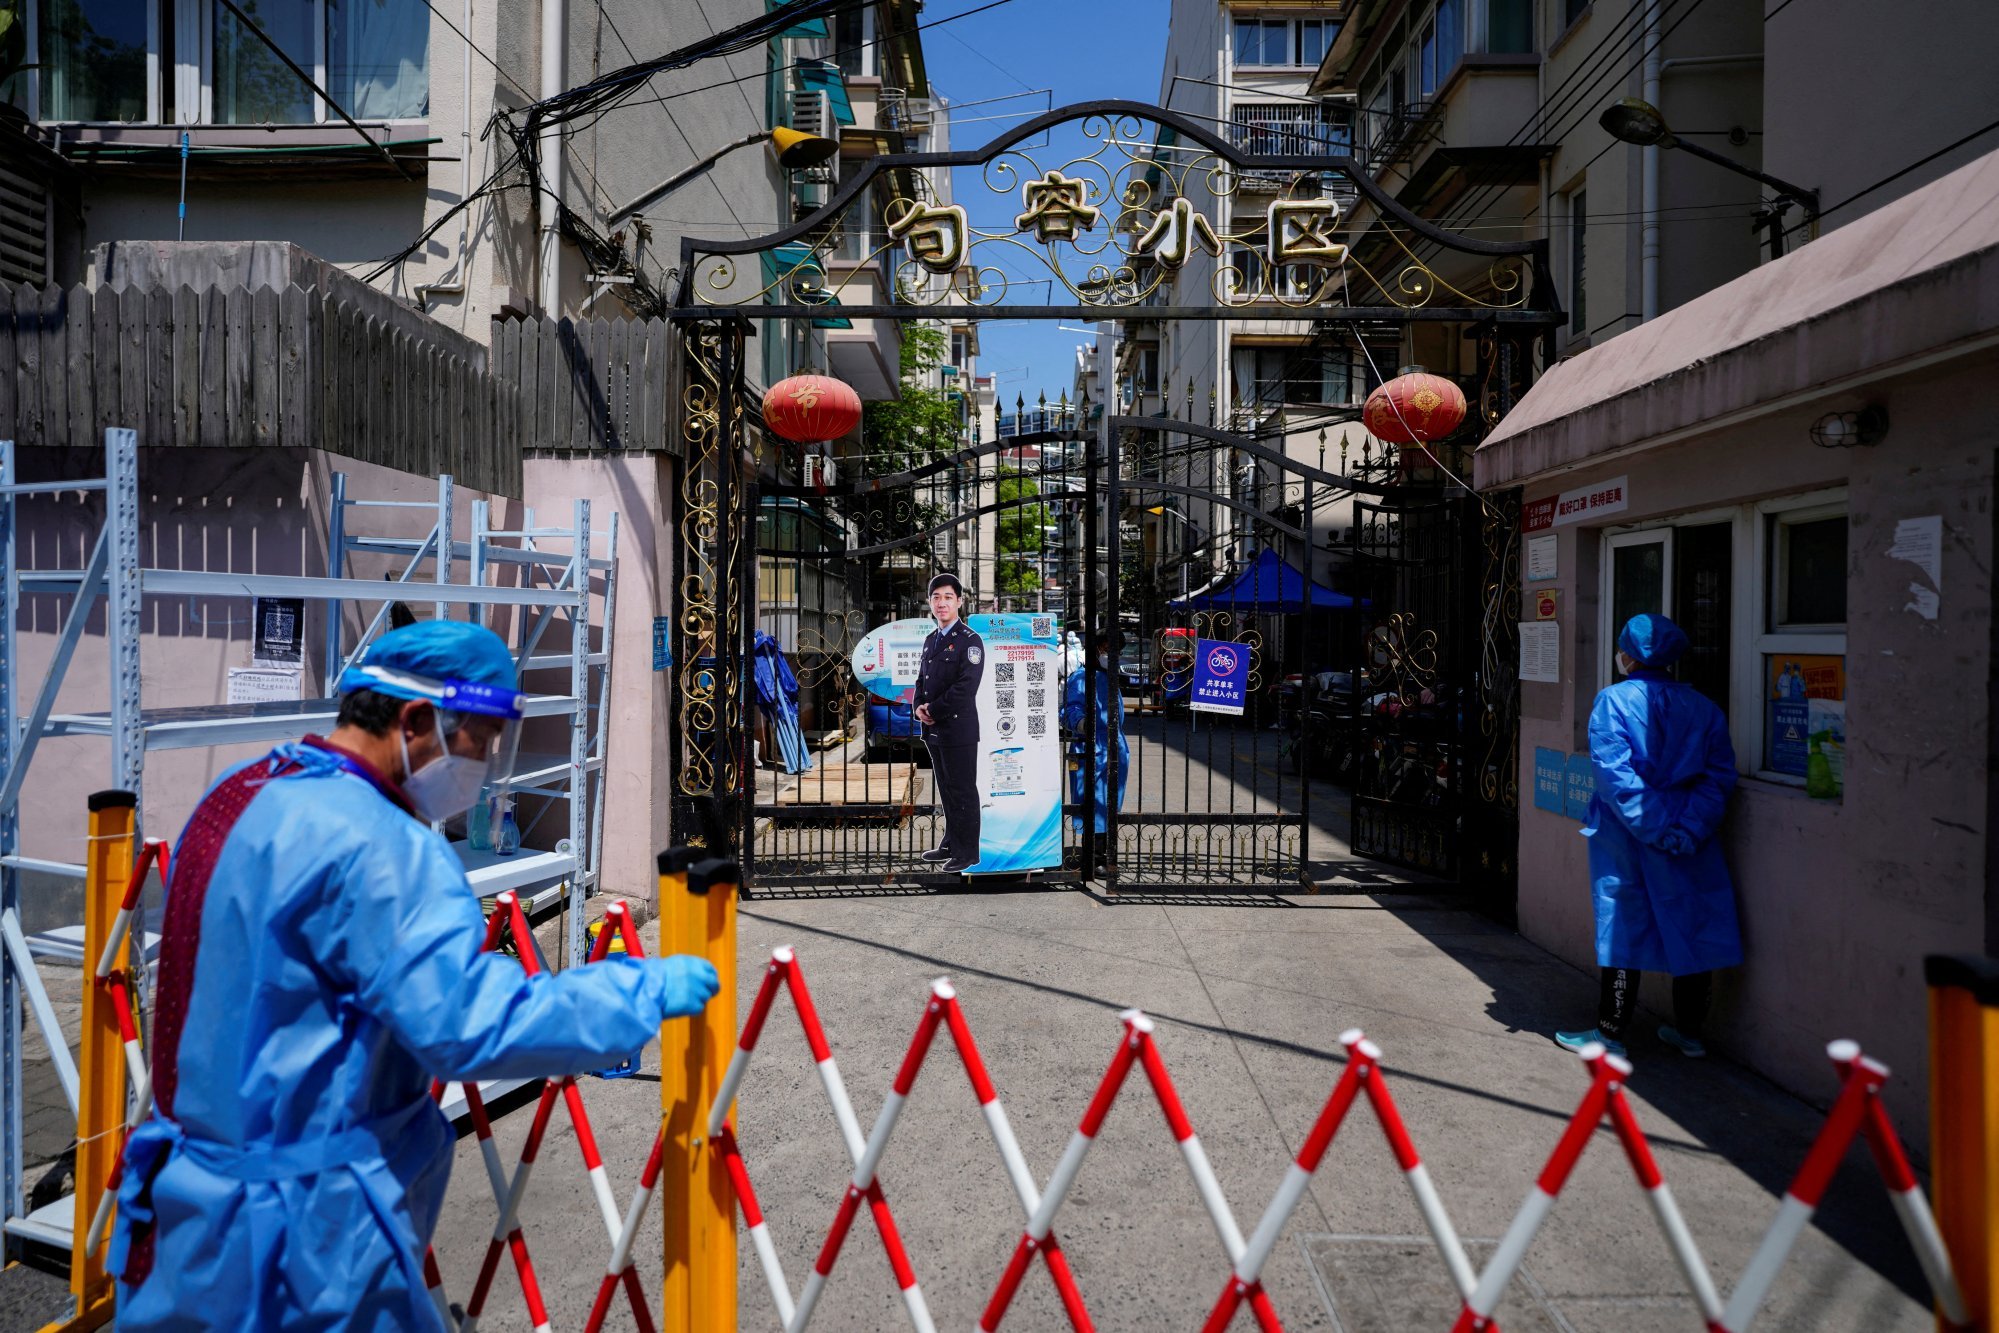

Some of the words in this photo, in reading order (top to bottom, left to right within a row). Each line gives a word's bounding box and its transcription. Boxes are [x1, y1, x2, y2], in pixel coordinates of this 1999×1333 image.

[887, 169, 1349, 274] 句容小区
[1559, 496, 1587, 516] 戴好口罩
[1590, 487, 1622, 508] 保持距离
[1198, 687, 1239, 700] 禁止进入小区
[1206, 679, 1233, 690] 共享单车
